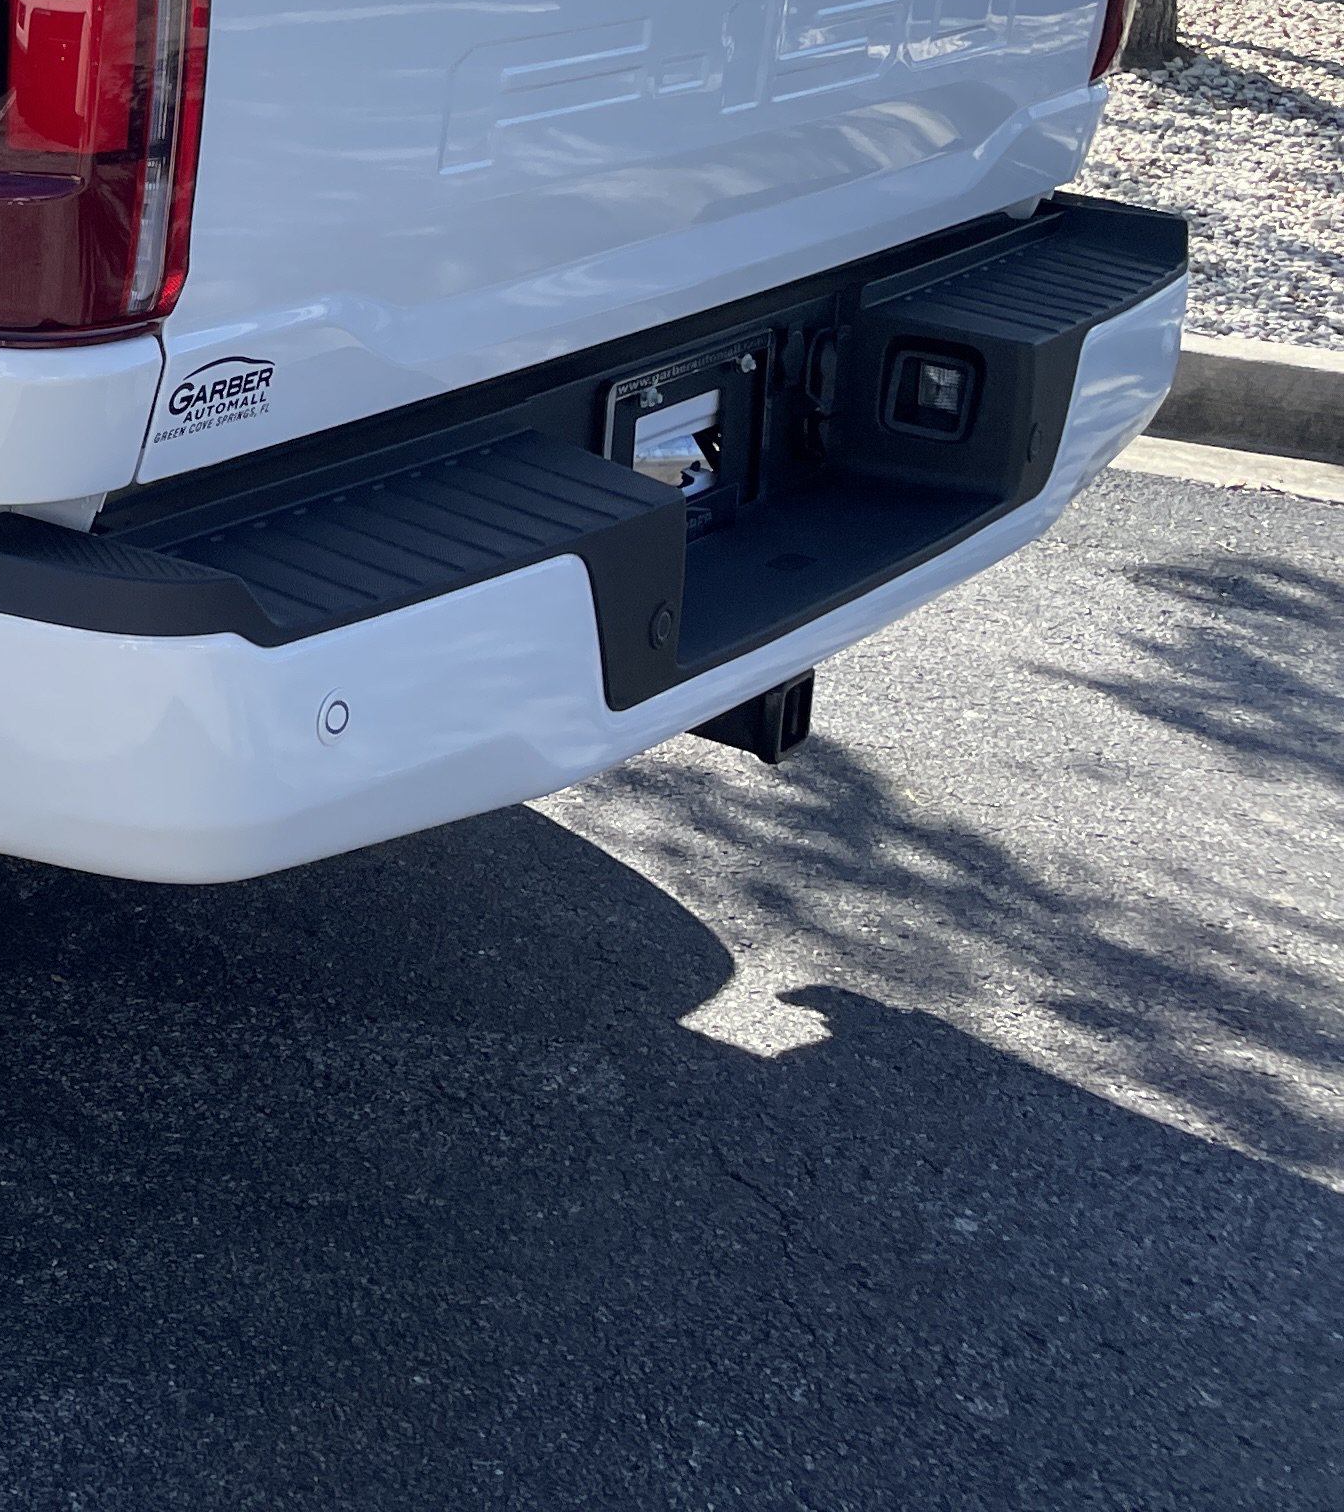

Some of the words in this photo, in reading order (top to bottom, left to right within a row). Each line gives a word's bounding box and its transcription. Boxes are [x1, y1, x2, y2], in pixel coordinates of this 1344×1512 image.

[168, 367, 274, 416] GARBER
[182, 391, 268, 424] AUTOMALL
[153, 426, 186, 444] GREEN
[188, 418, 213, 434] COVE
